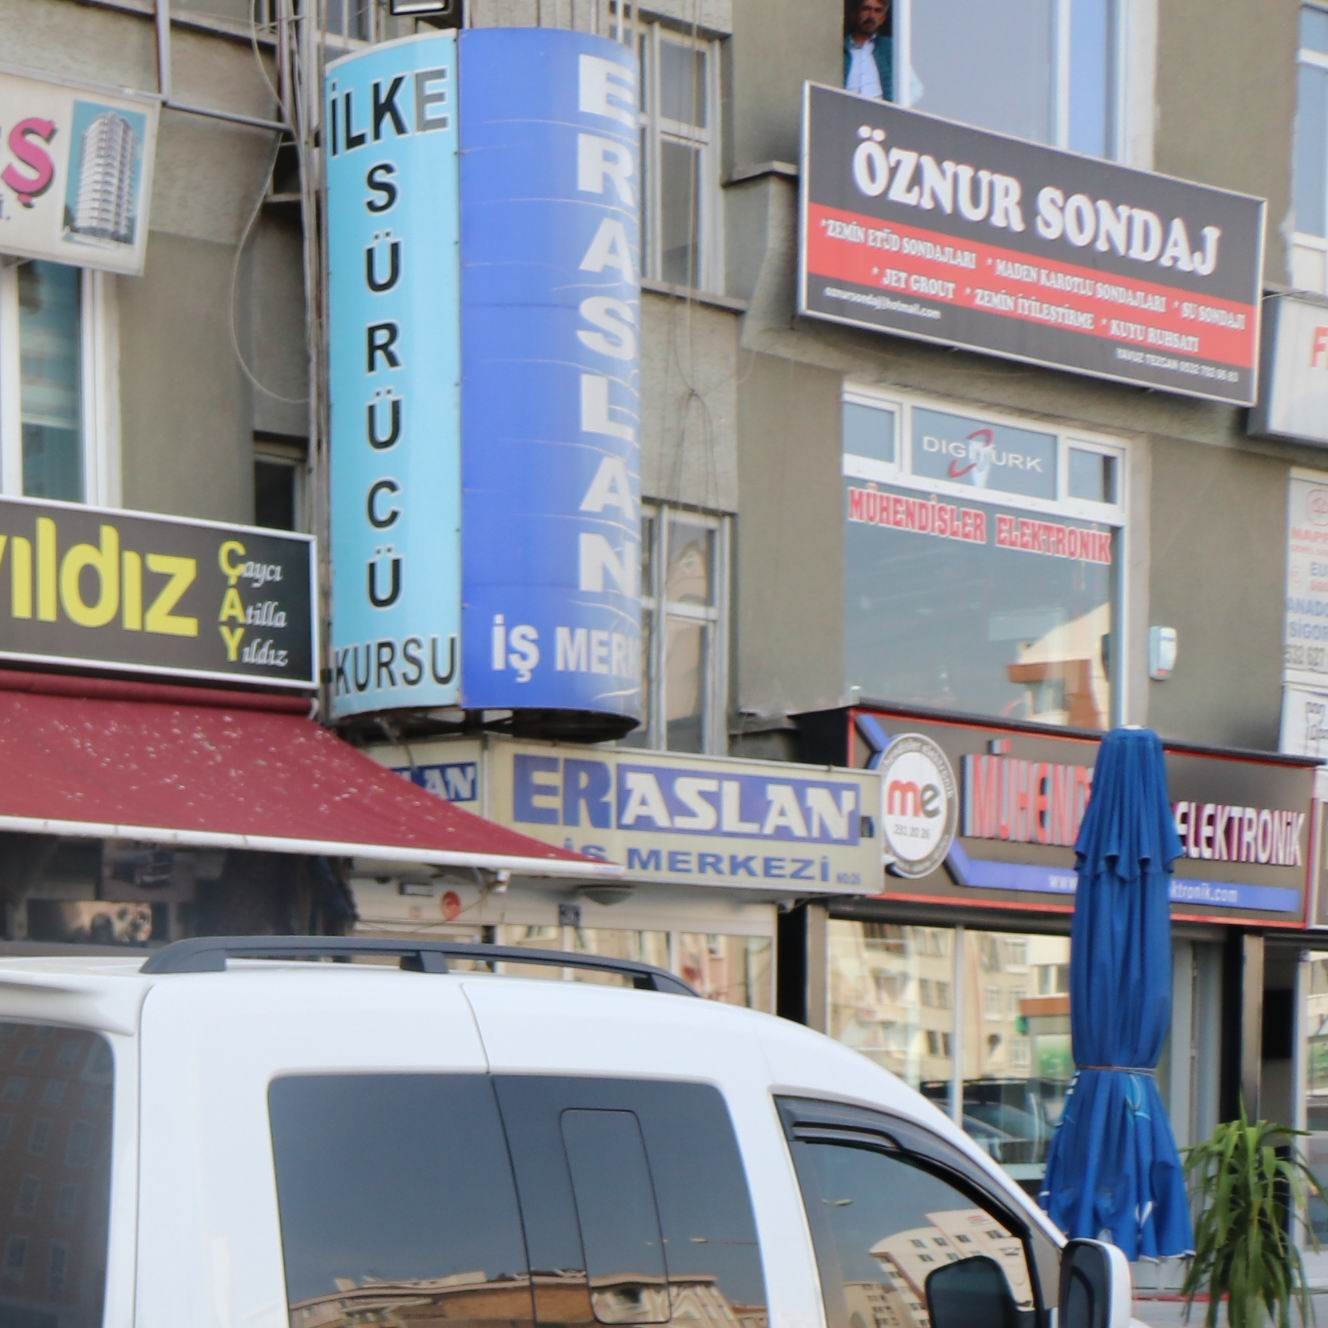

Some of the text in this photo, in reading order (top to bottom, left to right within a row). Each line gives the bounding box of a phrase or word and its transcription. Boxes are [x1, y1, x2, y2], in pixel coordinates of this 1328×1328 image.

[331, 67, 449, 157] İLKE
[852, 125, 1222, 276] ÖZNUR SONDAJ
[365, 162, 402, 609] SÜRÜCÜ
[848, 482, 1112, 565] MÜHENDİSLER ELEKTRONİK
[334, 636, 457, 697] KURSU
[491, 613, 541, 684] İŞ
[513, 753, 859, 842] ERASLAN
[887, 779, 941, 818] me
[627, 846, 832, 883] MERKEZİ
